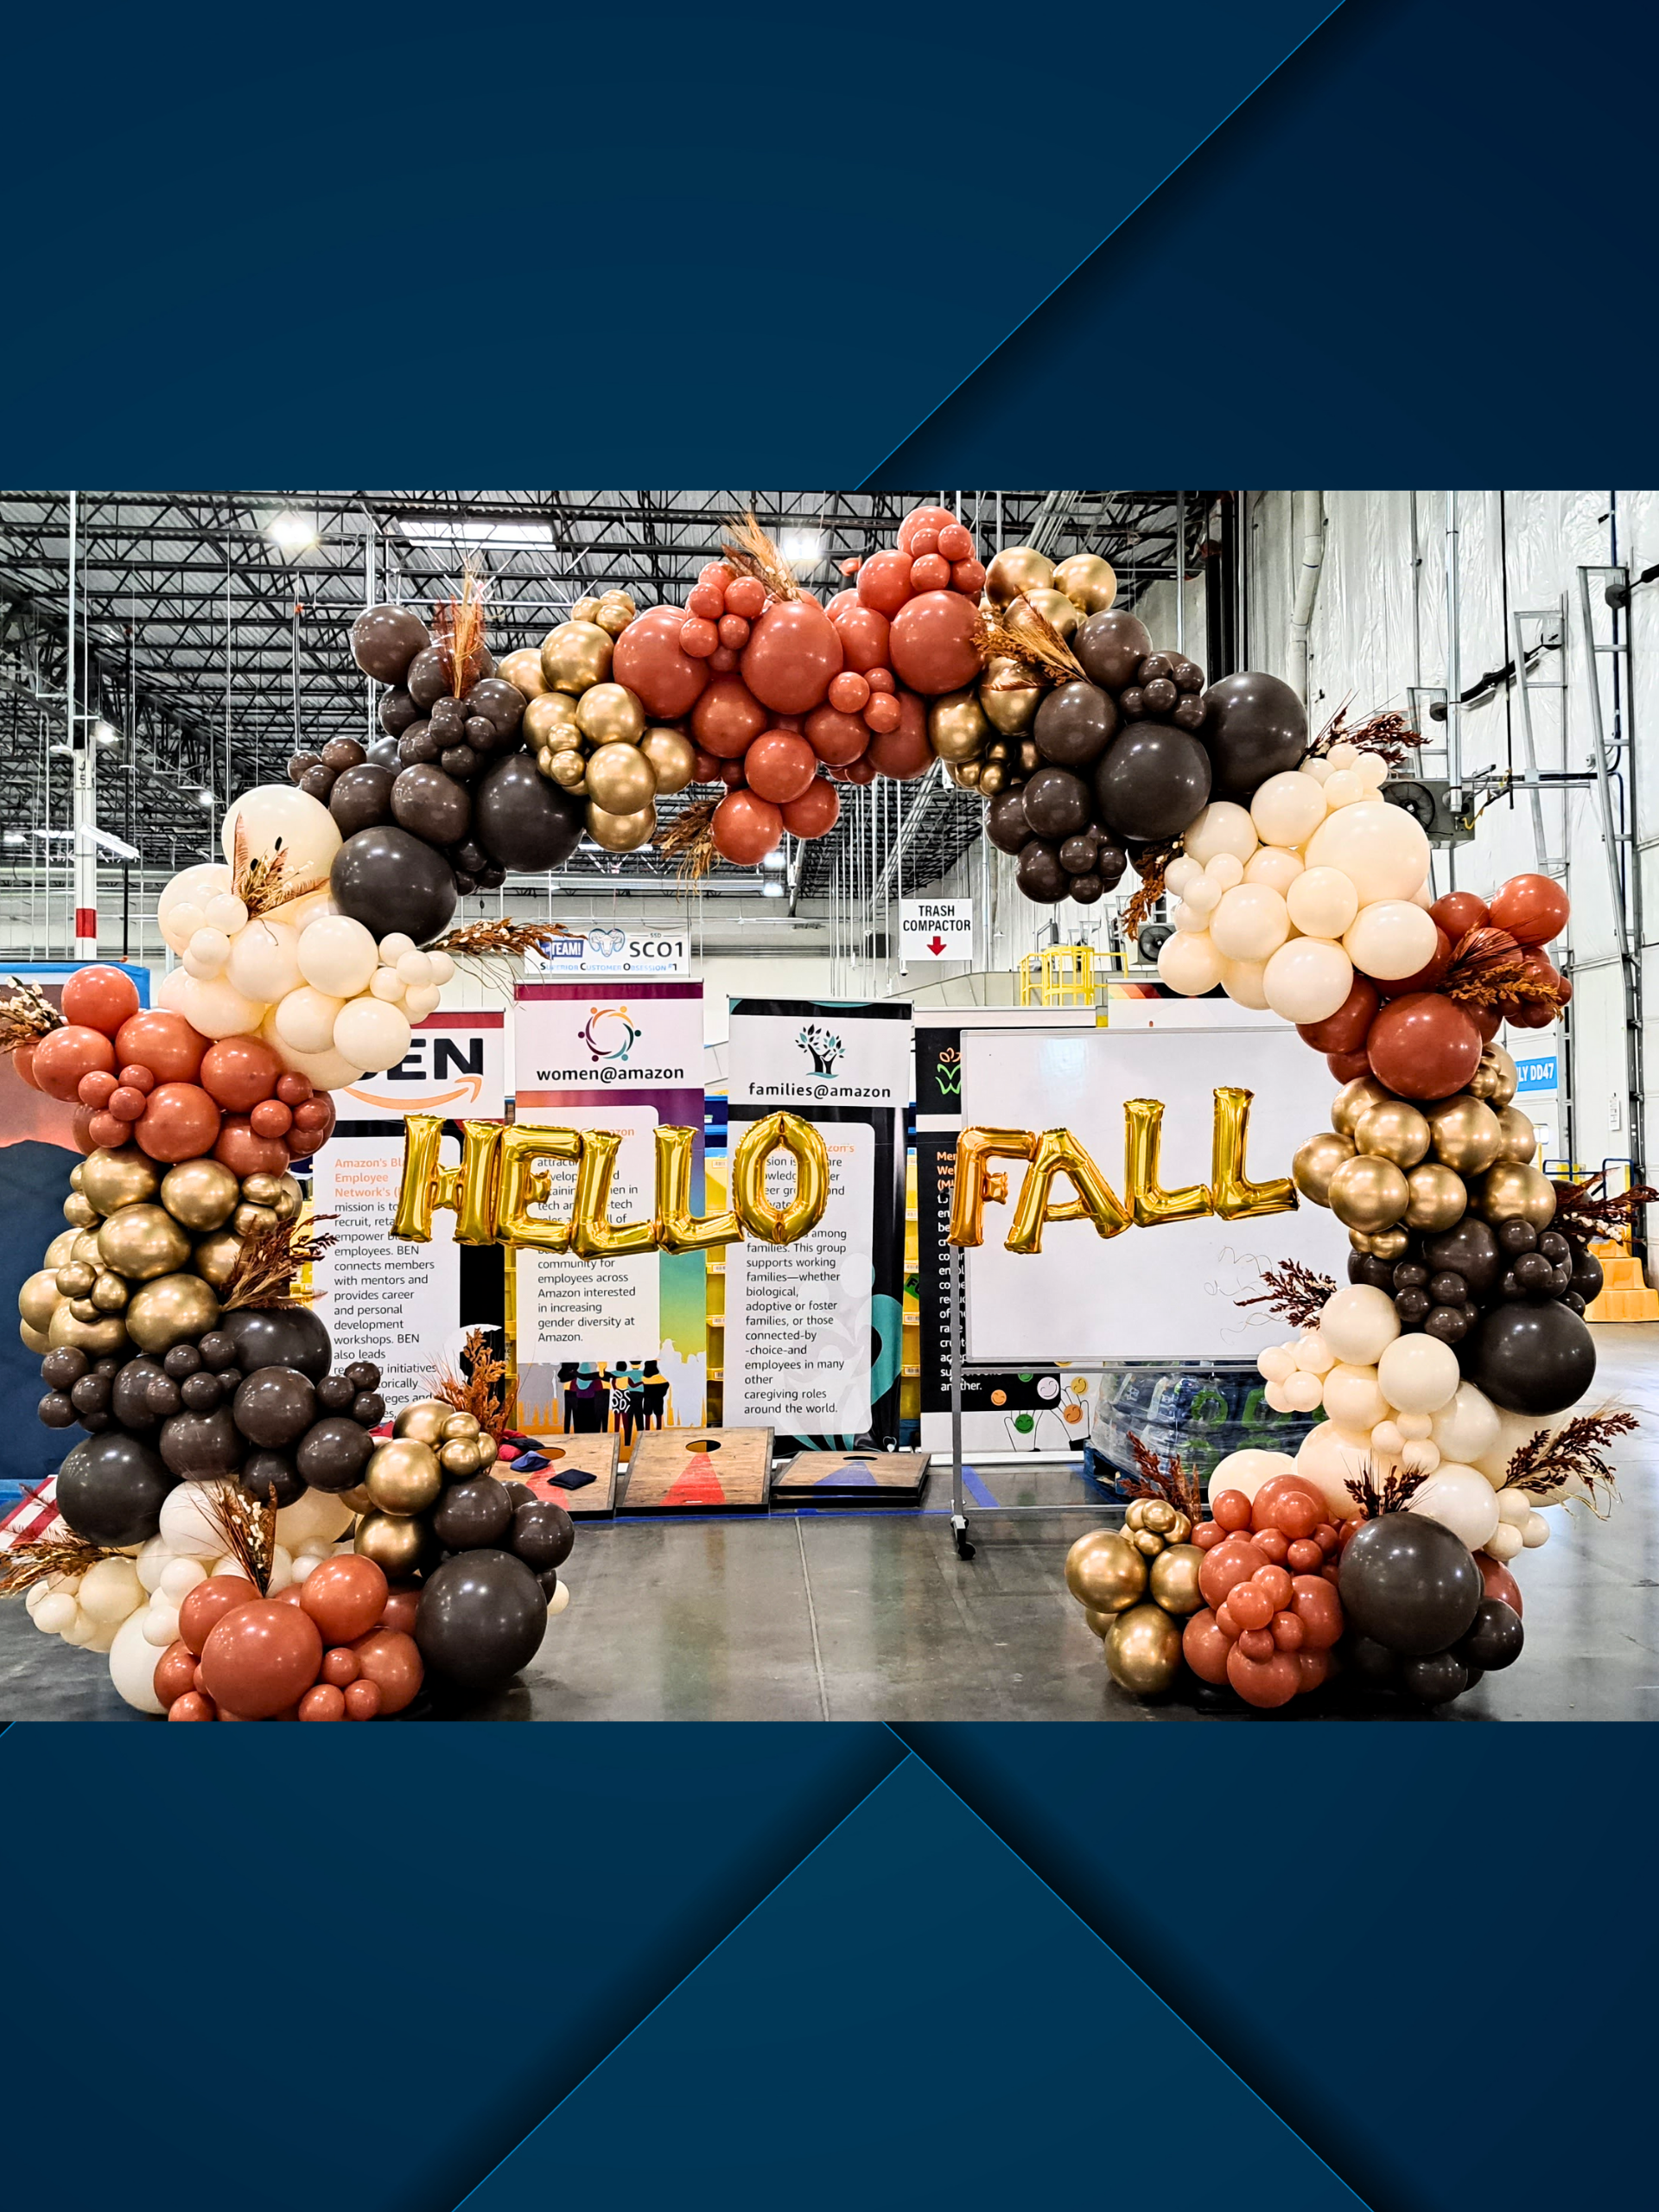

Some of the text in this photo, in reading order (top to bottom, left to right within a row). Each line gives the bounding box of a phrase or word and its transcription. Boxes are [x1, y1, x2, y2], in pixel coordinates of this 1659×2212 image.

[918, 905, 955, 917] TRASH
[903, 919, 971, 931] COMPACTOR
[552, 940, 582, 957] TEAM!
[629, 941, 683, 957] SCO1
[358, 1038, 484, 1080] EN
[537, 1066, 684, 1084] women@amazon
[1530, 1063, 1554, 1080] DD47
[748, 1083, 891, 1099] families@amazon
[334, 1158, 387, 1168] Amazon's
[334, 1173, 389, 1185] Employee
[391, 1086, 1300, 1261] HELLO FALL
[334, 1187, 390, 1198] Network's
[334, 1202, 374, 1211] mission
[378, 1202, 385, 1211] is
[607, 1199, 632, 1209] -tech
[334, 1217, 372, 1228] recruit,
[335, 1232, 385, 1243] empower
[811, 1230, 847, 1241] among
[334, 1246, 419, 1258] employees. BEN
[747, 1243, 847, 1255] families. This group
[334, 1261, 435, 1271] connects members
[537, 1260, 597, 1270] community
[747, 1257, 836, 1268] supports working
[334, 1274, 429, 1286] with mentors and
[537, 1274, 629, 1285] employees across
[334, 1291, 415, 1302] provides career
[537, 1287, 636, 1298] Amazon interested
[746, 1287, 798, 1298] biological,
[334, 1304, 403, 1317] and personal
[537, 1302, 602, 1314] in increasing
[746, 1300, 837, 1313] adoptive or foster
[334, 1319, 404, 1332] development
[537, 1316, 635, 1330] gender diversity at
[746, 1316, 834, 1327] families, or those
[334, 1334, 420, 1345] workshops. BEN
[537, 1332, 583, 1342] Amazon.
[745, 1331, 817, 1342] connected-by
[334, 1349, 386, 1359] also leads
[745, 1344, 807, 1355] -choice-and
[387, 1363, 437, 1374] initiatives
[745, 1359, 844, 1371] employees in many
[744, 1374, 773, 1384] other
[941, 1380, 982, 1391] anther.
[744, 1389, 827, 1401] caregiving roles
[744, 1402, 838, 1414] around the world.
